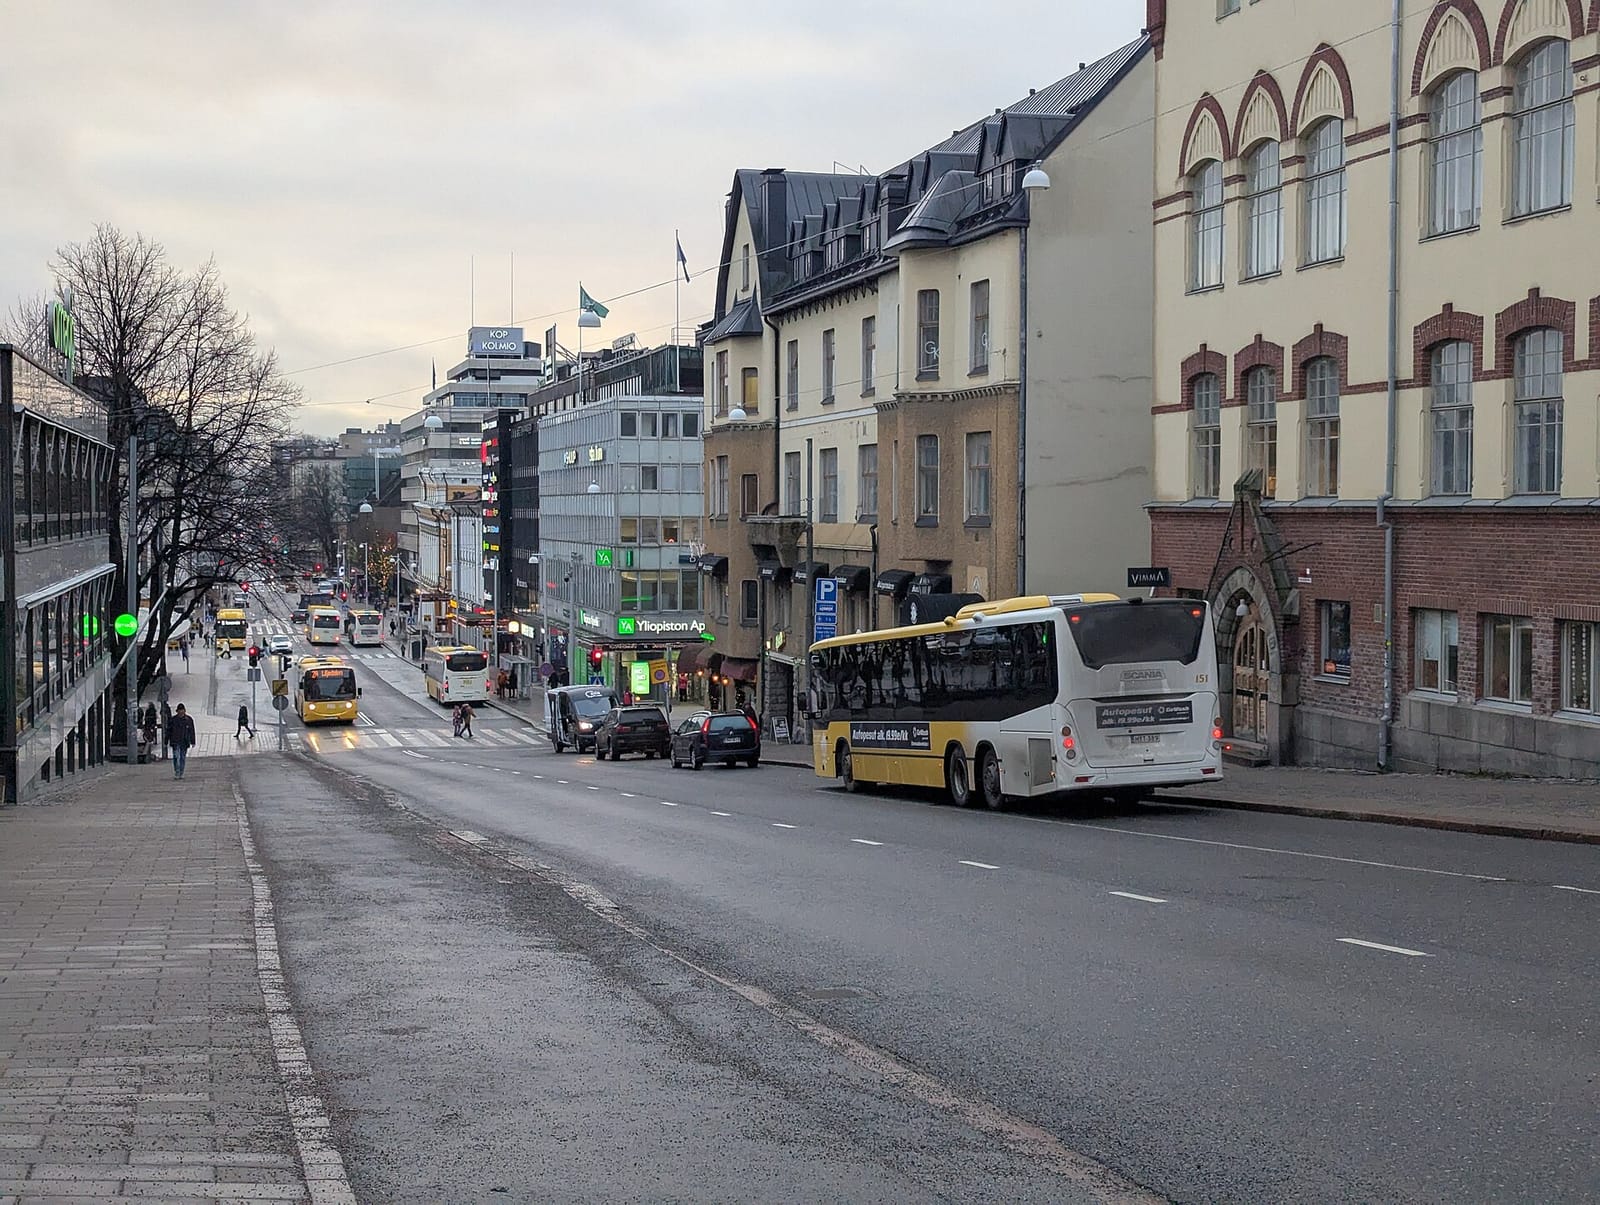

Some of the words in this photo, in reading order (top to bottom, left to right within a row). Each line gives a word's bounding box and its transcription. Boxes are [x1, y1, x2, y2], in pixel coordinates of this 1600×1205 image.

[489, 330, 508, 339] KOP
[482, 341, 517, 351] KOLMIO
[597, 551, 610, 564] YA
[1131, 570, 1164, 584] VIMMA
[821, 581, 834, 599] P
[636, 620, 688, 634] Yliopiston
[1123, 671, 1163, 680] SCANIA
[1195, 674, 1208, 683] 151
[1102, 706, 1152, 717] Autopesut
[852, 729, 876, 742] Autopesut
